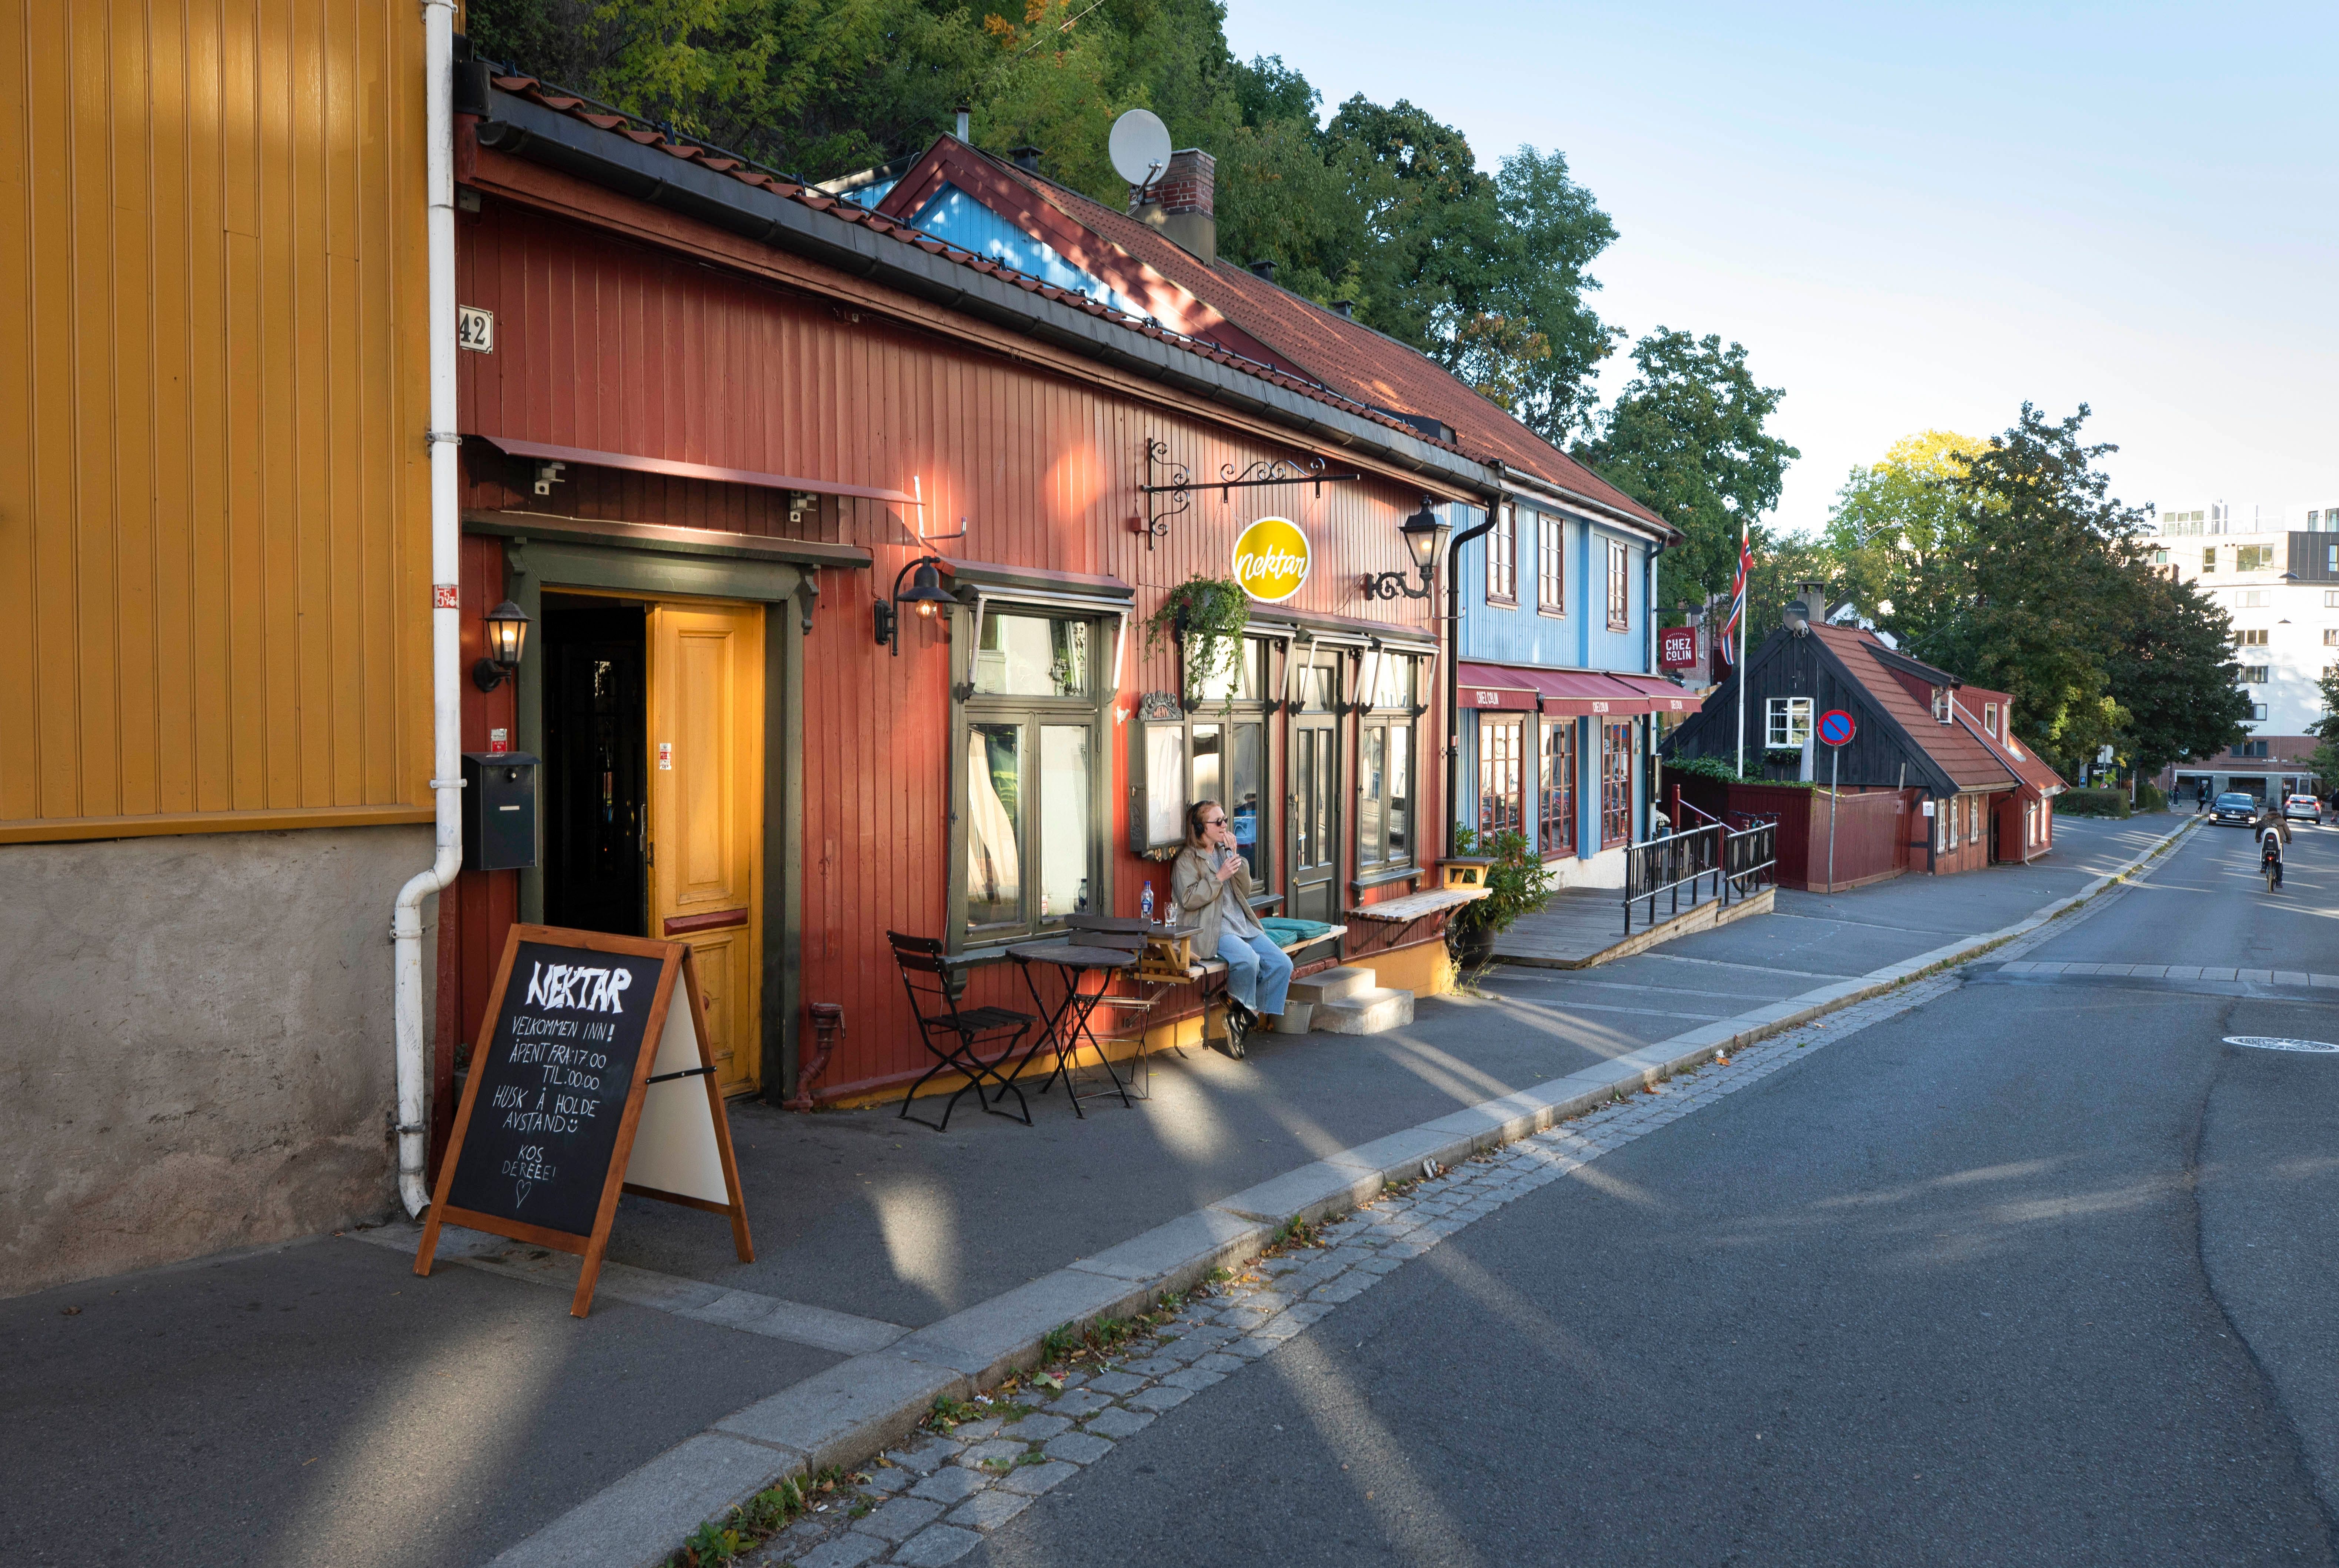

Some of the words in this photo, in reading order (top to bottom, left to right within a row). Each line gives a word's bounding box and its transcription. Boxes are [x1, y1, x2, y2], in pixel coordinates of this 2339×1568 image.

[460, 313, 486, 345] 42
[1235, 544, 1306, 581] nektar
[1666, 638, 1691, 651] CHEZ
[1476, 691, 1488, 704] CHEZ
[1593, 701, 1601, 713] CHEZ
[524, 961, 632, 1014] NEKTAR
[512, 1016, 578, 1038] VELKOMMEN
[583, 1022, 615, 1042] INN!
[509, 1038, 551, 1063] ÅPENT
[493, 1085, 528, 1108] HUSK
[536, 1087, 546, 1111] Å
[555, 1094, 601, 1117] HOLDE
[503, 1111, 565, 1134] AVSTAND
[518, 1144, 544, 1163] KOS
